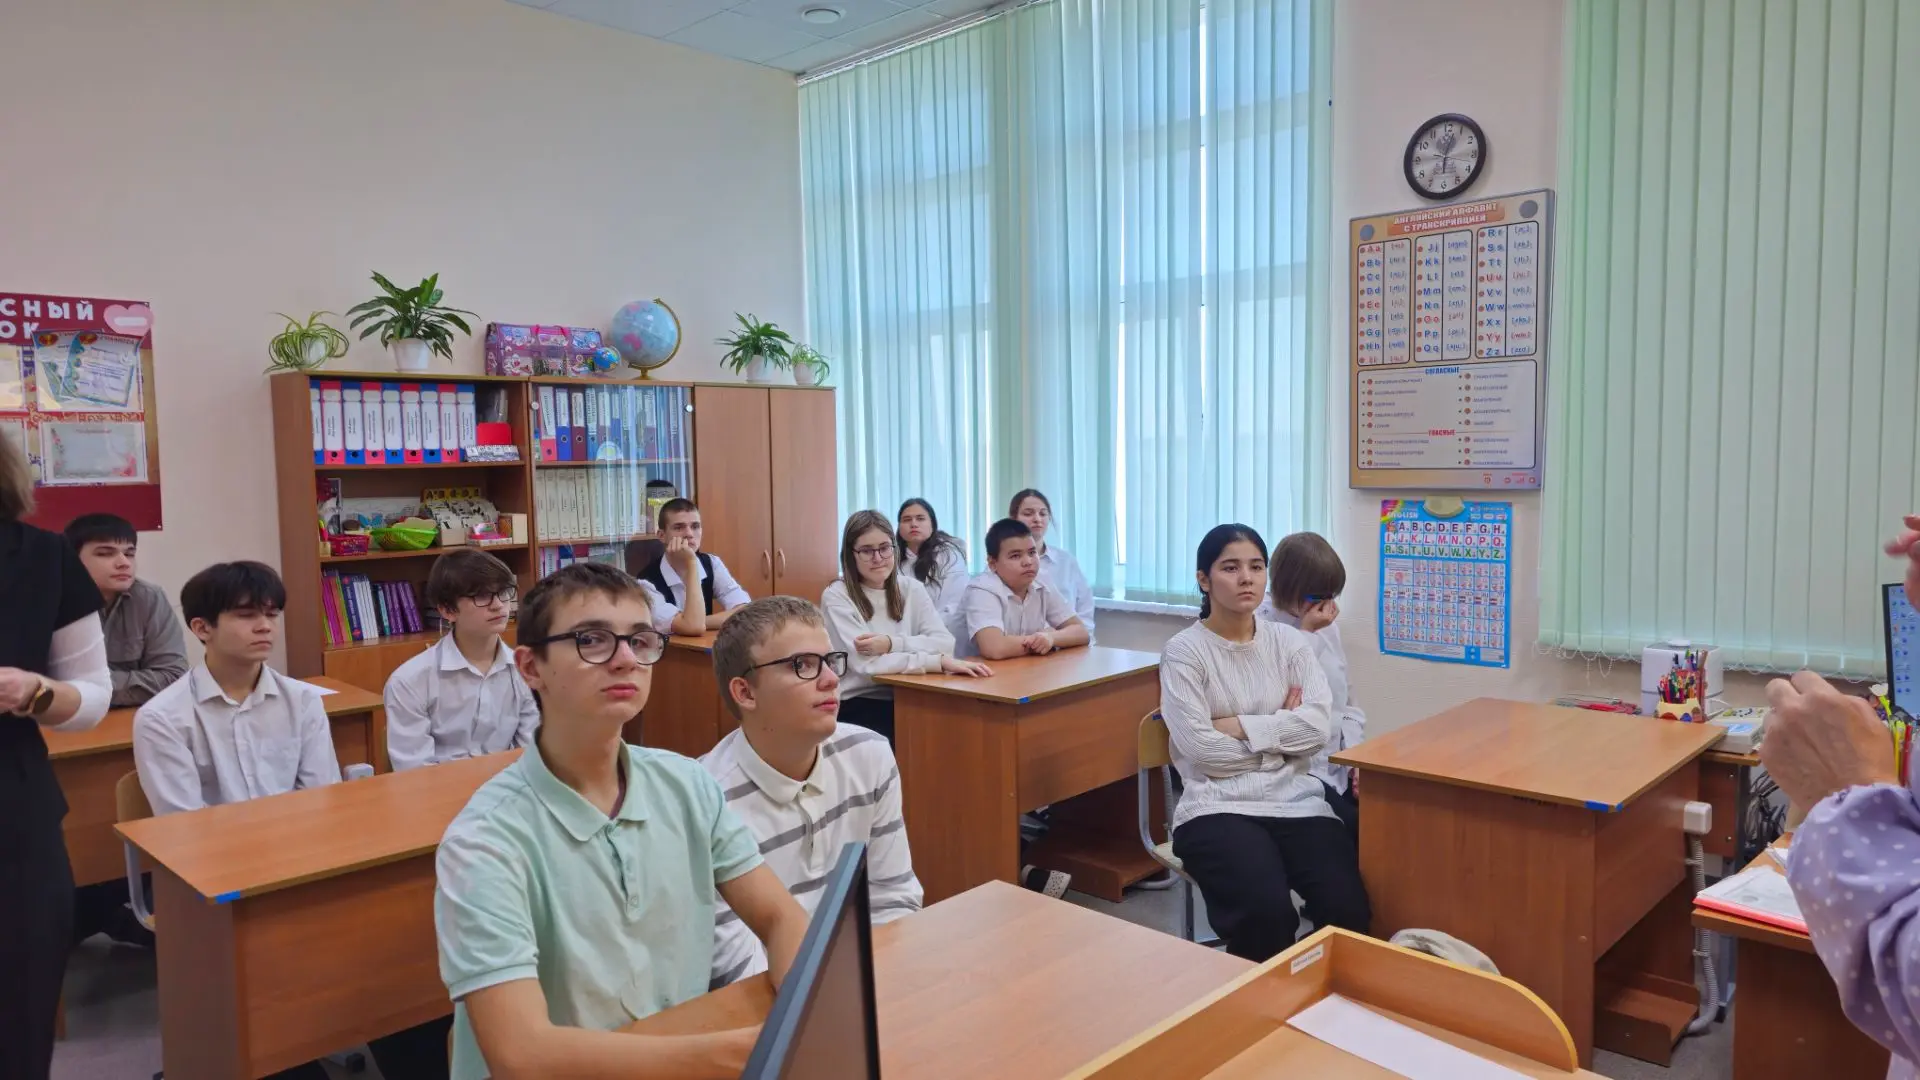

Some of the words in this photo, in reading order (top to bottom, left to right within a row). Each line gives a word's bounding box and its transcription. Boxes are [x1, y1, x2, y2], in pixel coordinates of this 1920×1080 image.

[1444, 123, 1453, 133] 12
[1467, 135, 1474, 145] 2
[1418, 141, 1429, 151] 10
[1465, 164, 1471, 173] 4
[1419, 169, 1425, 179] 8
[1440, 180, 1447, 189] 6
[1454, 175, 1461, 185] 5
[1394, 209, 1451, 225] АНГЛИЙСКИЙ
[1452, 202, 1497, 216] АЛФАВИТ
[1412, 214, 1486, 231] ТРАНСКРИПЦИЕЙ
[0, 298, 93, 320] СНЫЙ
